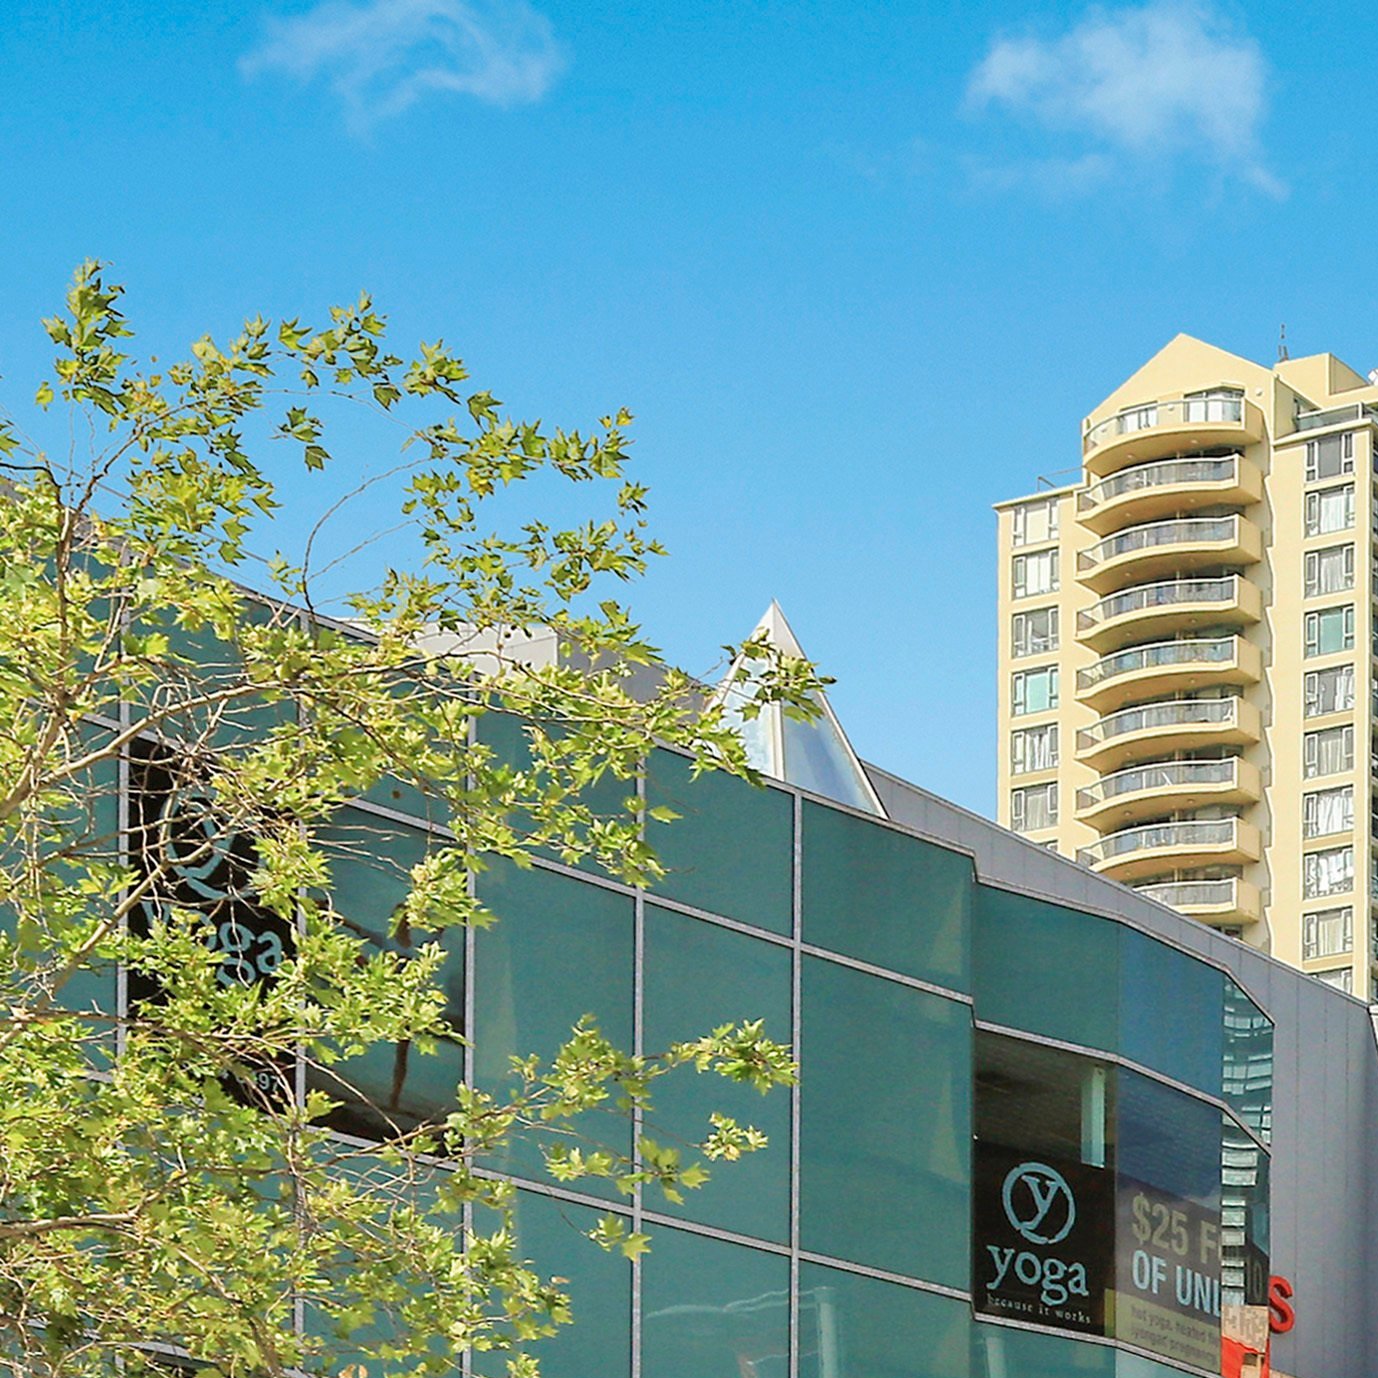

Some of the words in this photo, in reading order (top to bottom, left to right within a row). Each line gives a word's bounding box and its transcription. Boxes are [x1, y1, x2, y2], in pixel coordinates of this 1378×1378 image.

[1132, 1192, 1189, 1256] $25
[986, 1245, 1089, 1306] yoga
[1132, 1250, 1167, 1293] OF
[1056, 1305, 1091, 1324] works
